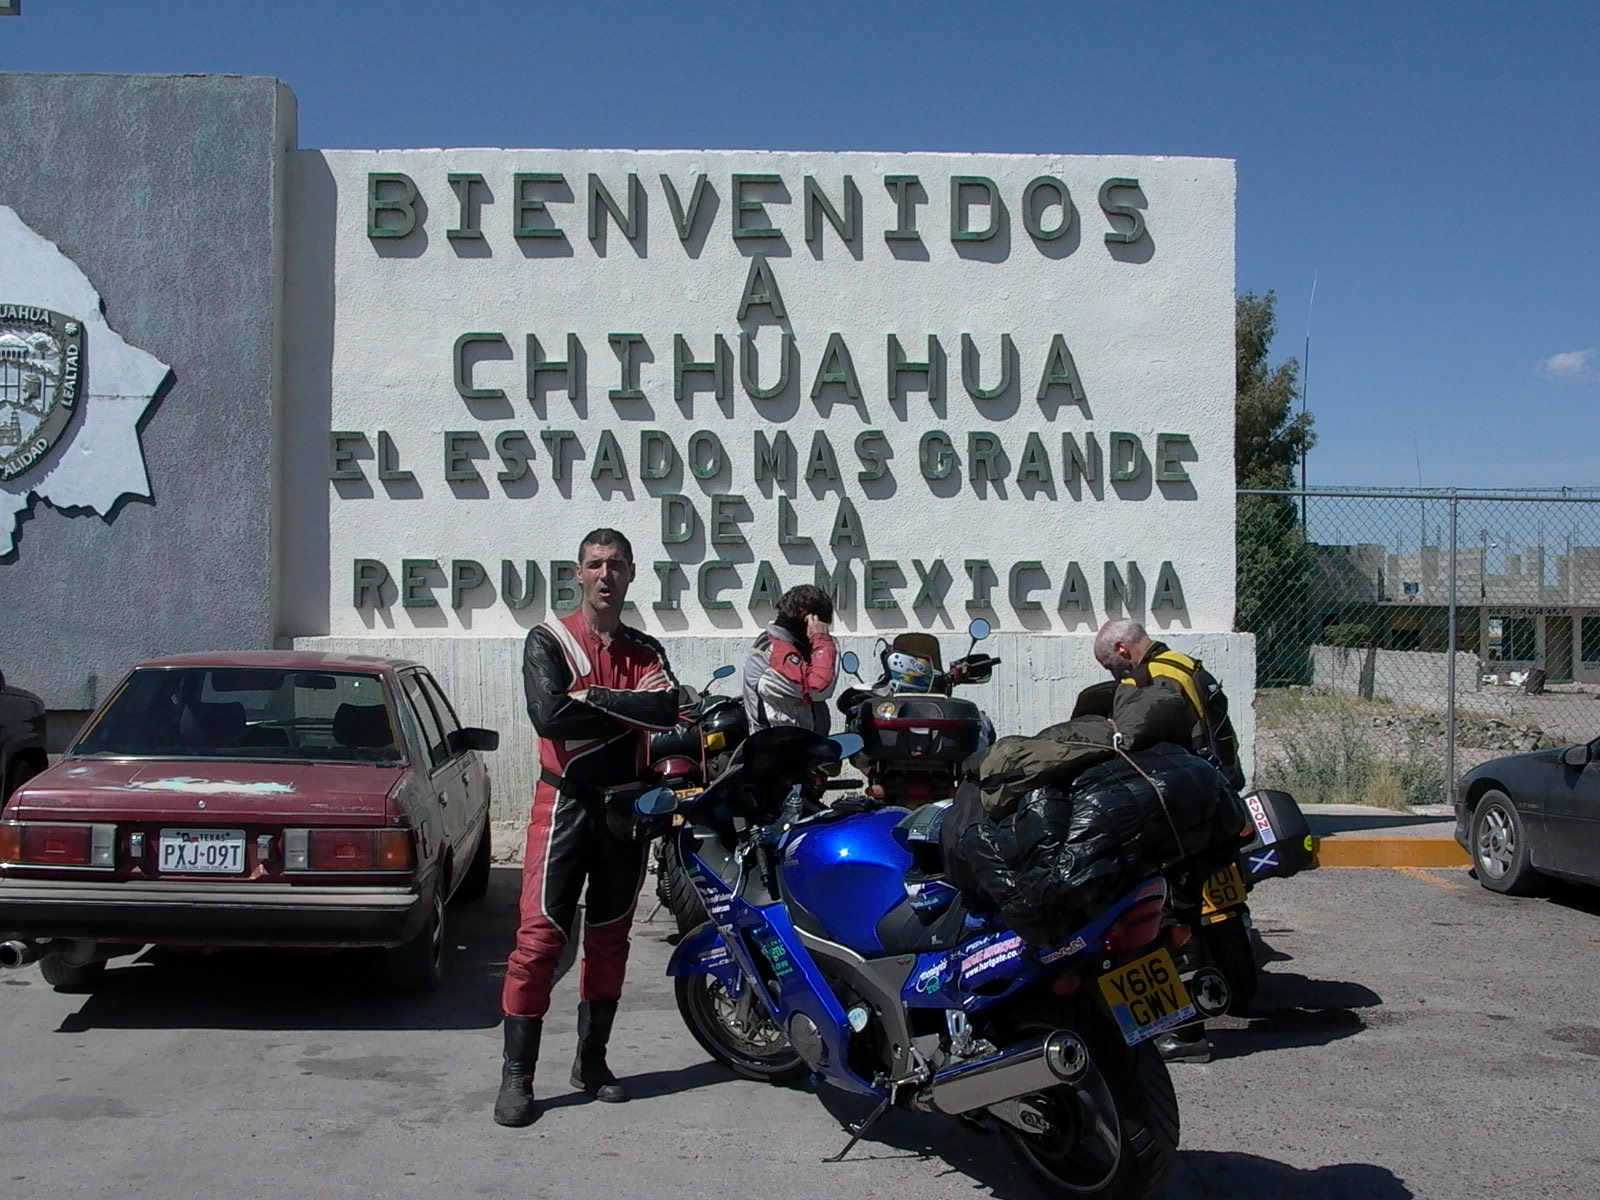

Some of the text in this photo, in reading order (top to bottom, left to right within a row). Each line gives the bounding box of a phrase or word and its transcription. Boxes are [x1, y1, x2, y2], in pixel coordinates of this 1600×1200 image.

[367, 172, 1146, 243] BIENVENIDOS
[736, 253, 785, 320] A
[61, 344, 79, 408] LEALTAD
[453, 333, 1087, 400] CHIHUAHUA
[0, 438, 48, 477] ALIDAD
[330, 430, 1190, 482] EL ESTADO MAS GRANDE
[661, 494, 860, 547] DE LA
[814, 559, 1186, 611] MEXICANA
[199, 833, 225, 842] TEXAS
[1249, 798, 1269, 829] AVON
[1110, 958, 1169, 1002] Y616
[1130, 983, 1179, 1027] GWV
